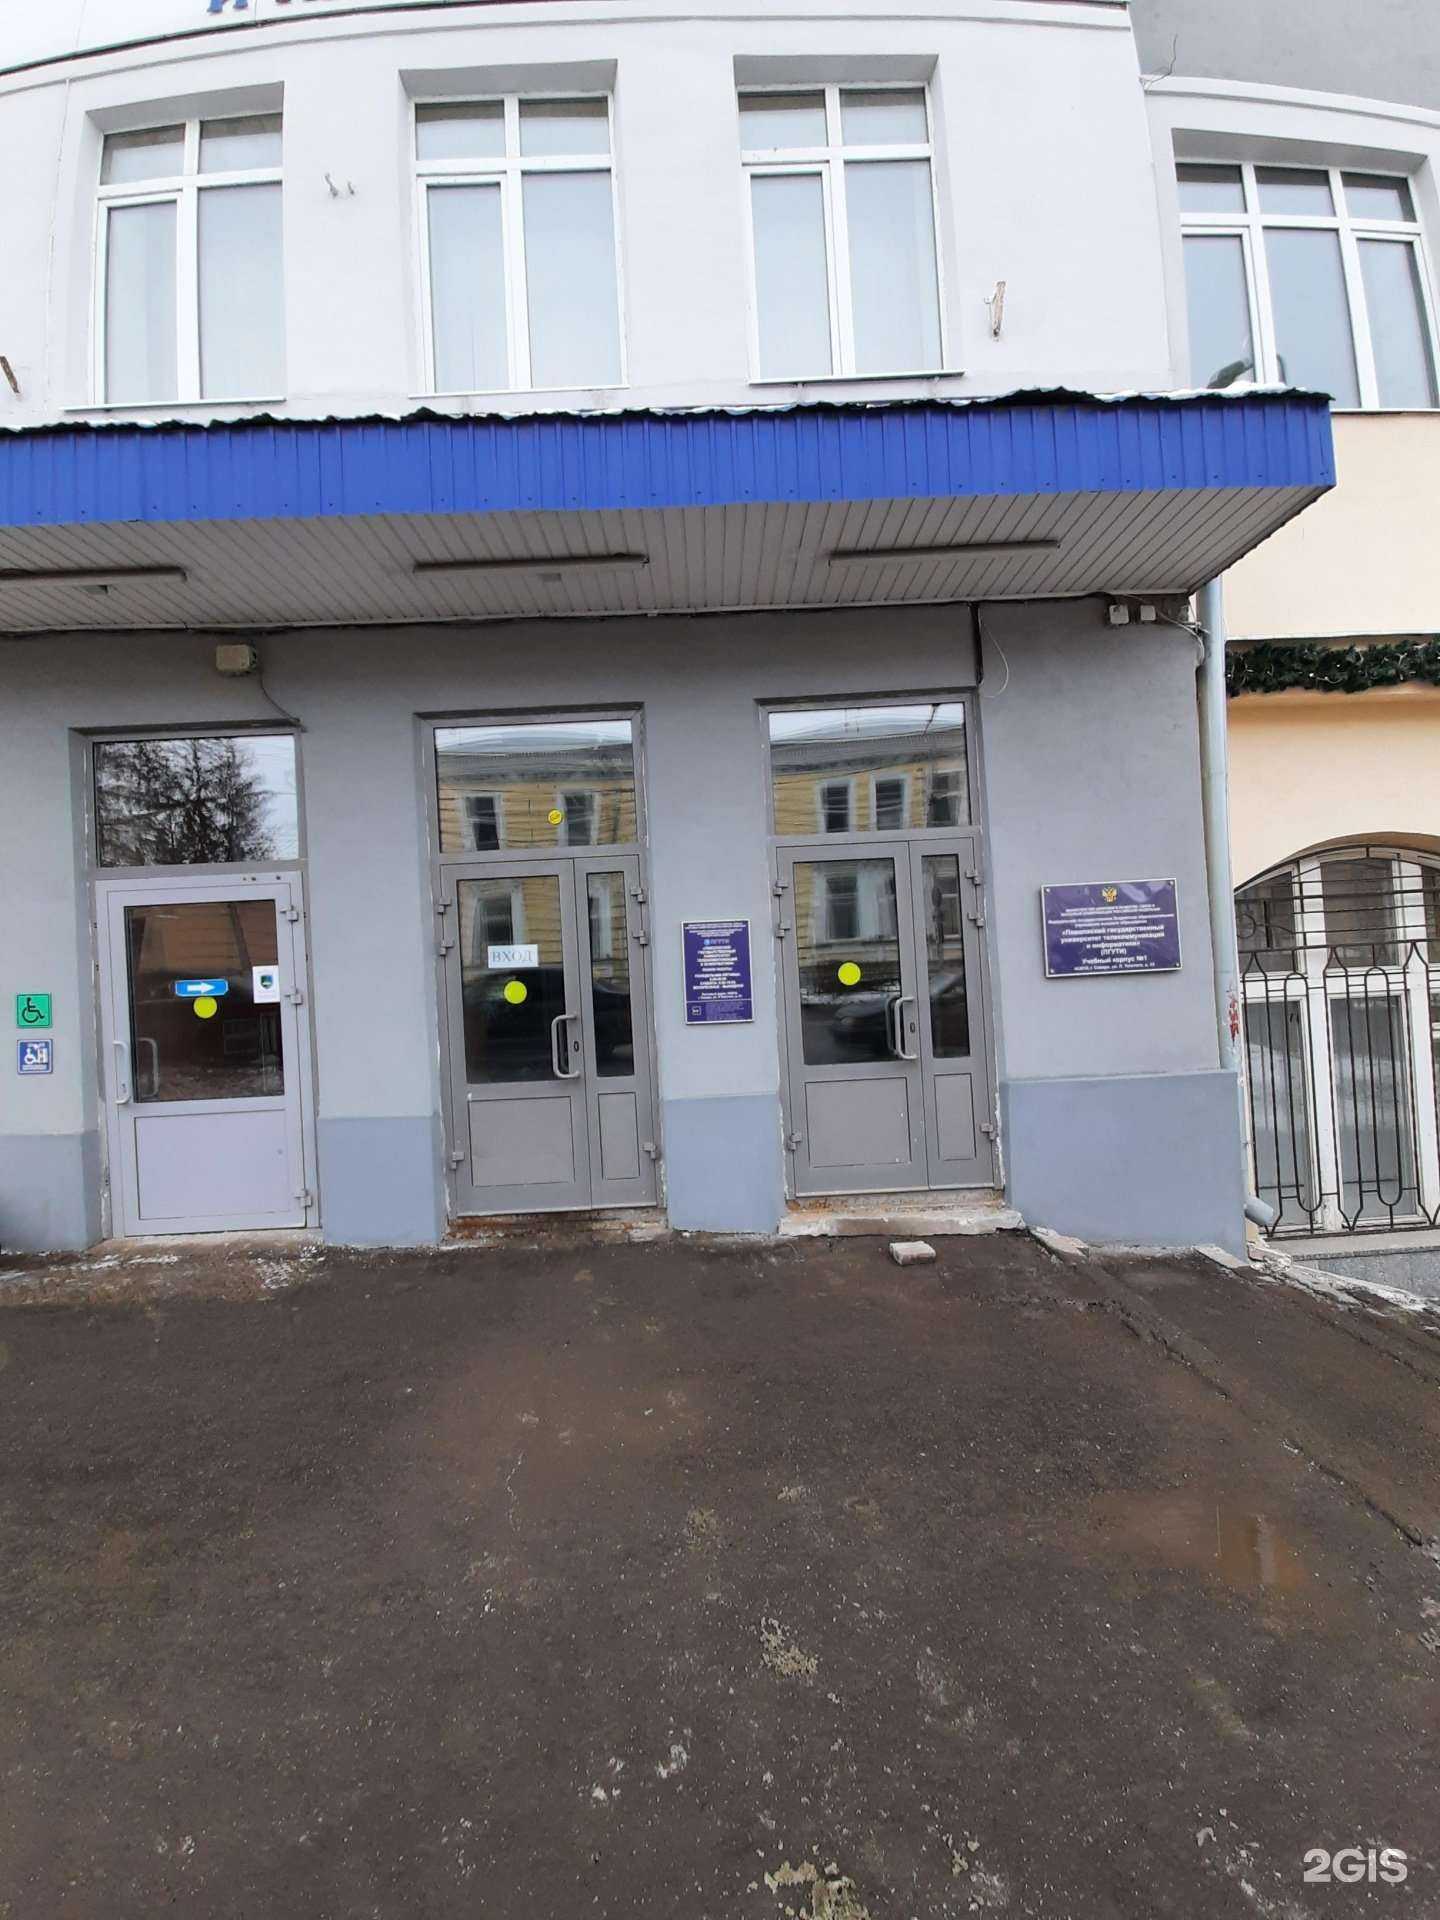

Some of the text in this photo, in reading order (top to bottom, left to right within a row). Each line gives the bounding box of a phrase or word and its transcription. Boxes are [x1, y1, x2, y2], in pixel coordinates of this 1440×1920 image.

[1107, 925, 1164, 933] государственный
[1060, 936, 1101, 944] университет
[493, 950, 535, 963] ВХОД
[1082, 956, 1111, 964] Учебный
